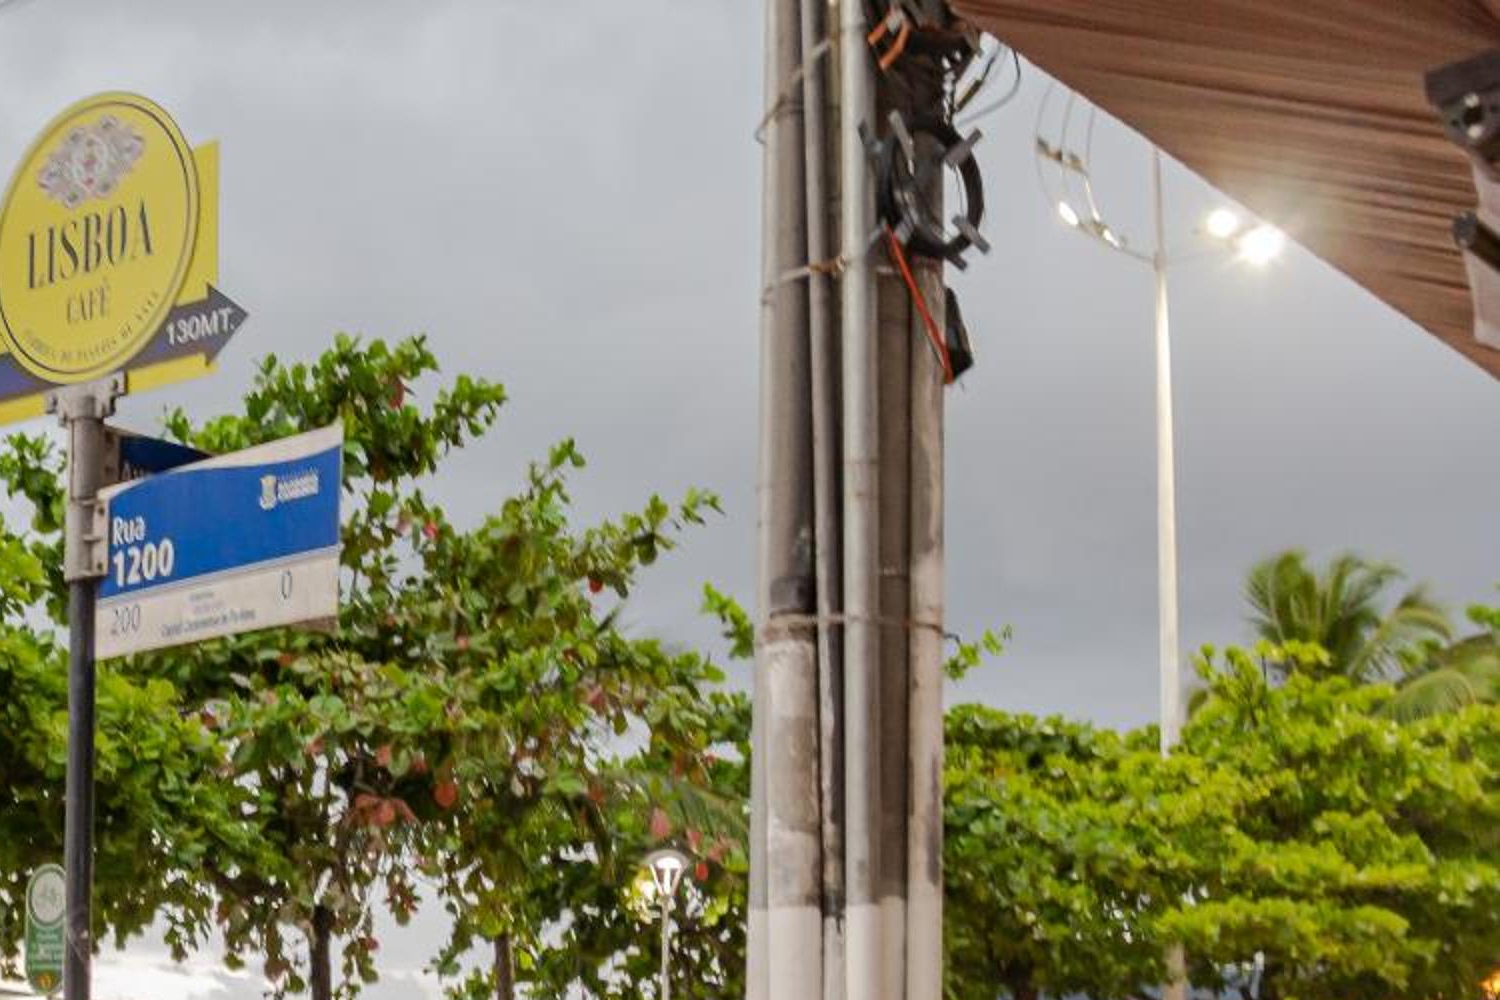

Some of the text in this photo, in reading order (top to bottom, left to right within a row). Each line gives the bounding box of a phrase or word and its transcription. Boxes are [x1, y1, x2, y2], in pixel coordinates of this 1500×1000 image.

[28, 200, 153, 289] LISBOA
[112, 515, 146, 547] Rua
[112, 537, 175, 588] 1200
[110, 603, 141, 638] 200
[280, 569, 294, 602] 0
